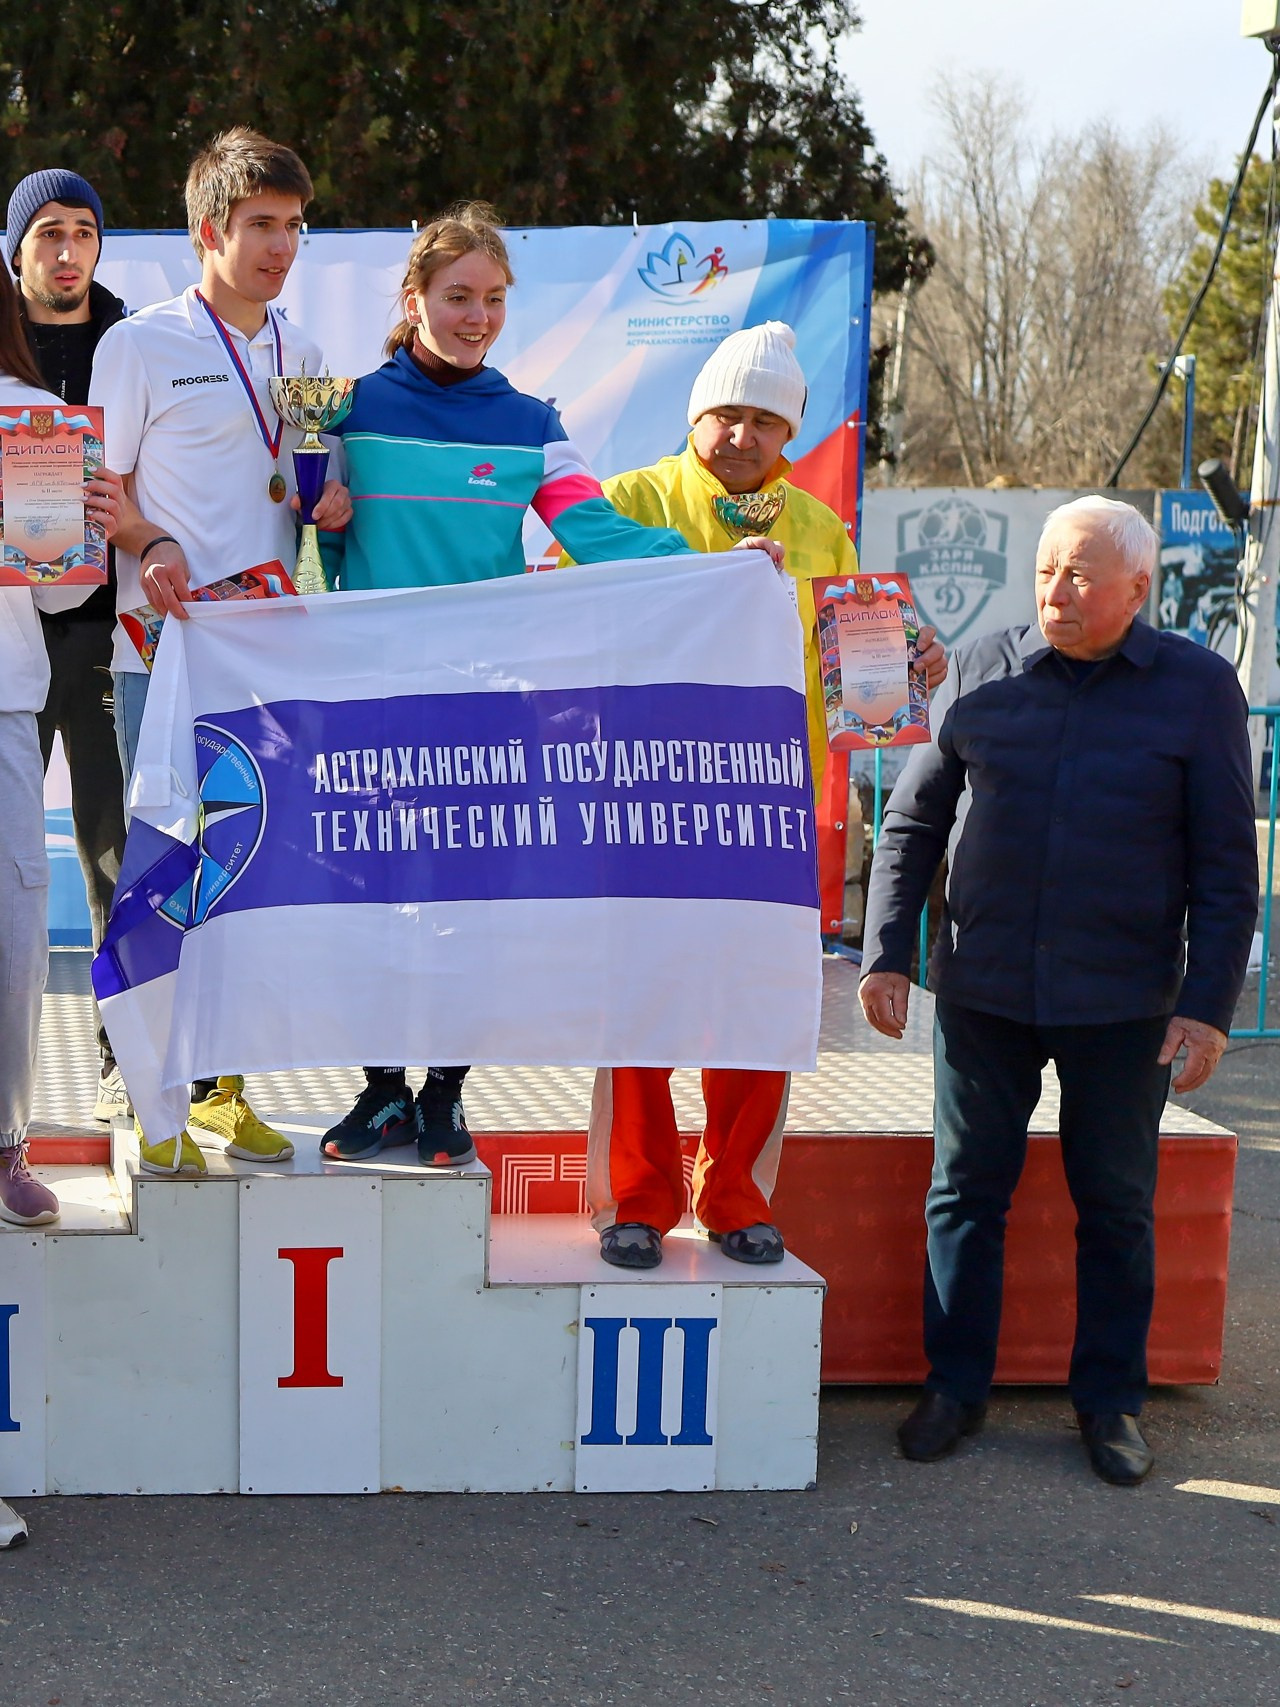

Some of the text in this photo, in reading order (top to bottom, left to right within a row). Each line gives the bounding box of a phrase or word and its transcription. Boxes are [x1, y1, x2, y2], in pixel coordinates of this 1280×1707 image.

[627, 315, 731, 328] МИНИСТЕРСТВО
[626, 336, 725, 346] АСТРАХАНСКОЙ ОБЛАС
[171, 374, 230, 388] PROGRESS
[6, 444, 80, 457] ДИПЛОМ
[1171, 502, 1236, 537] Подго
[929, 549, 974, 561] ЗАРЯ
[919, 562, 984, 575] КАСПИЯ
[839, 609, 900, 624] ДИПЛОМ
[314, 738, 805, 794] АСТРАХАНСКИЙ ГОСУДАРСТВЕННЫЙ
[311, 796, 808, 853] ТЕХНИЧЕСКИЙ УНИВЕРСИТЕТ
[277, 1246, 344, 1388] I
[580, 1317, 718, 1447] III
